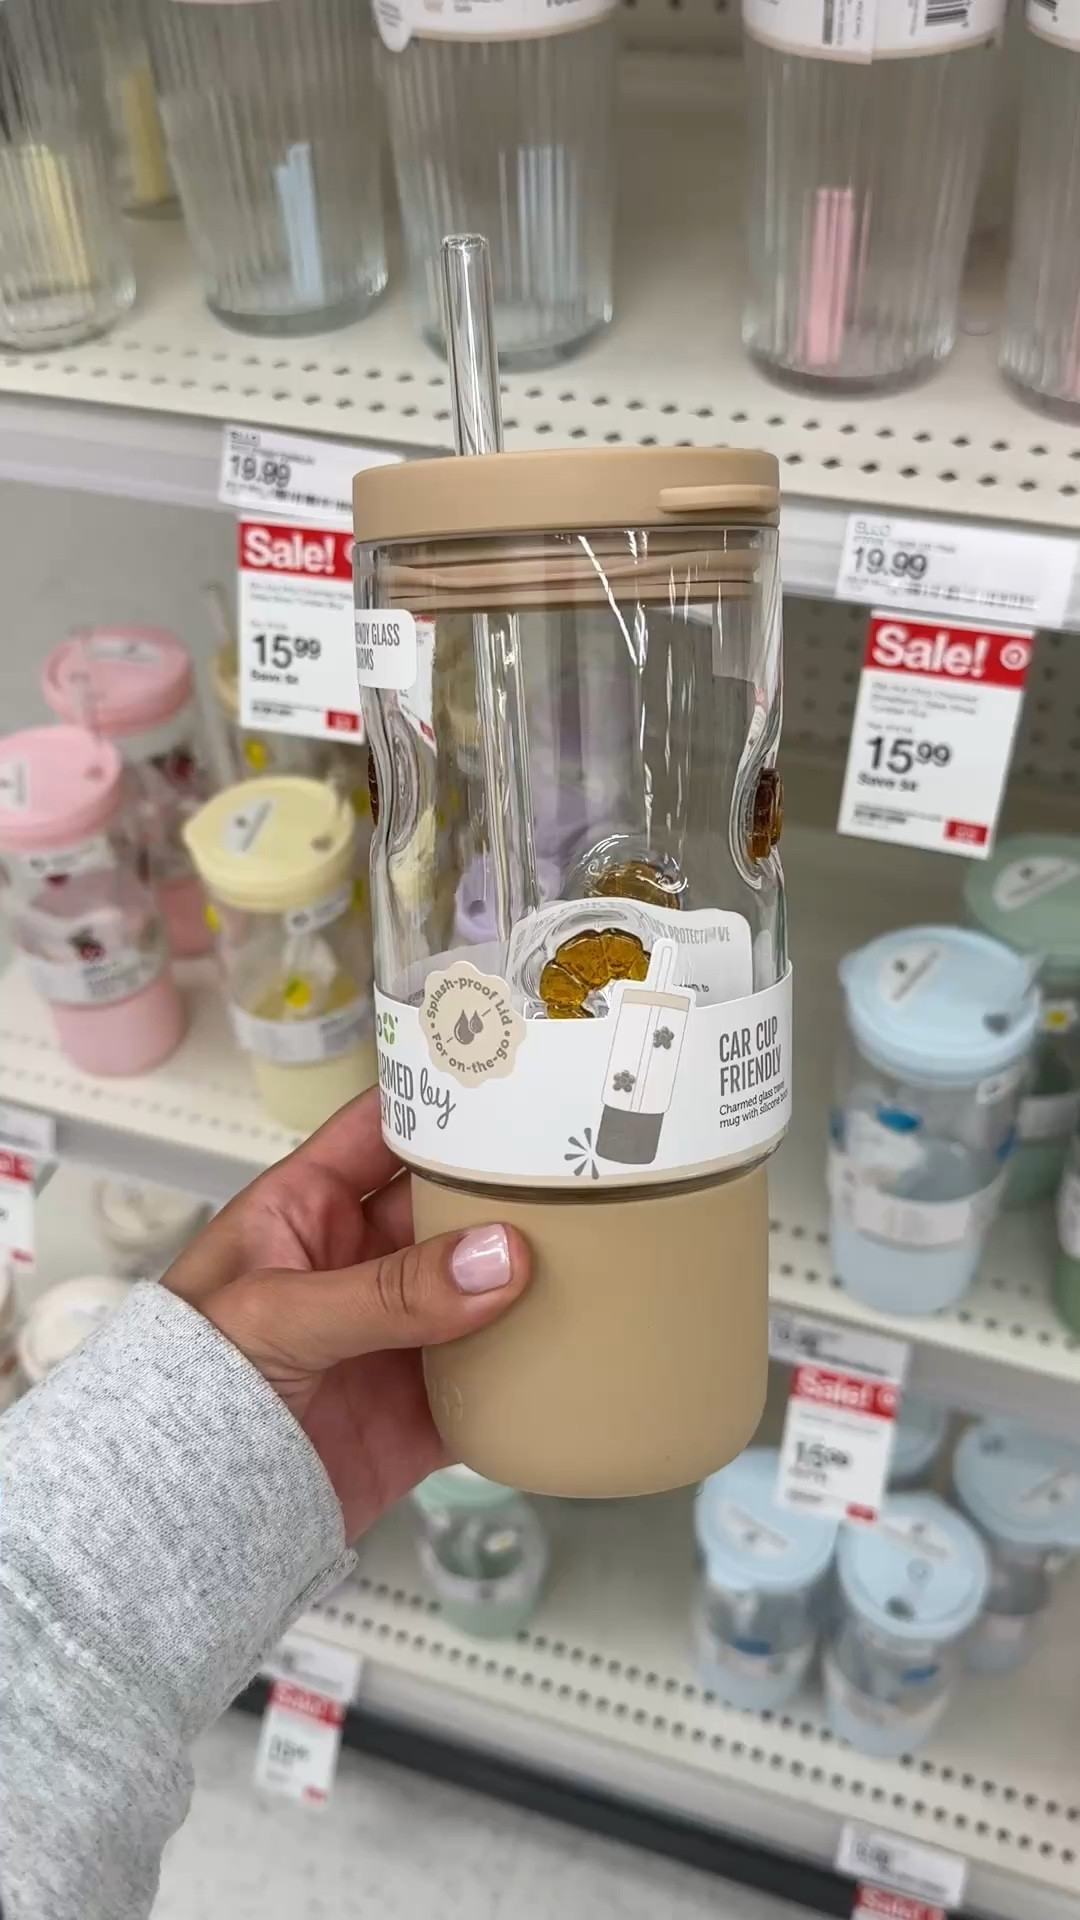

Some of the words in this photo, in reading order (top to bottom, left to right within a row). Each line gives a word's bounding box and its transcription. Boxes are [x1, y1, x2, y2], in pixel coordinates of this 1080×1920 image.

[230, 456, 292, 488] 19.99
[243, 527, 336, 575] Sale!
[853, 546, 928, 580] 19.99
[371, 623, 400, 646] GLASS
[872, 624, 989, 679] Sale!
[427, 977, 499, 1019] Splash-proof
[495, 1000, 512, 1026] Lid
[432, 1032, 448, 1057] For
[448, 1039, 510, 1073] on-the-go
[719, 1027, 752, 1063] CAR
[756, 1015, 778, 1051] CUP
[720, 1044, 782, 1096] FRIENDLY
[420, 1067, 457, 1130] by
[719, 1094, 758, 1116] Charmed
[758, 1088, 774, 1105] glass
[719, 1115, 741, 1128] mug
[742, 1106, 759, 1122] with
[395, 1100, 416, 1141] SIP
